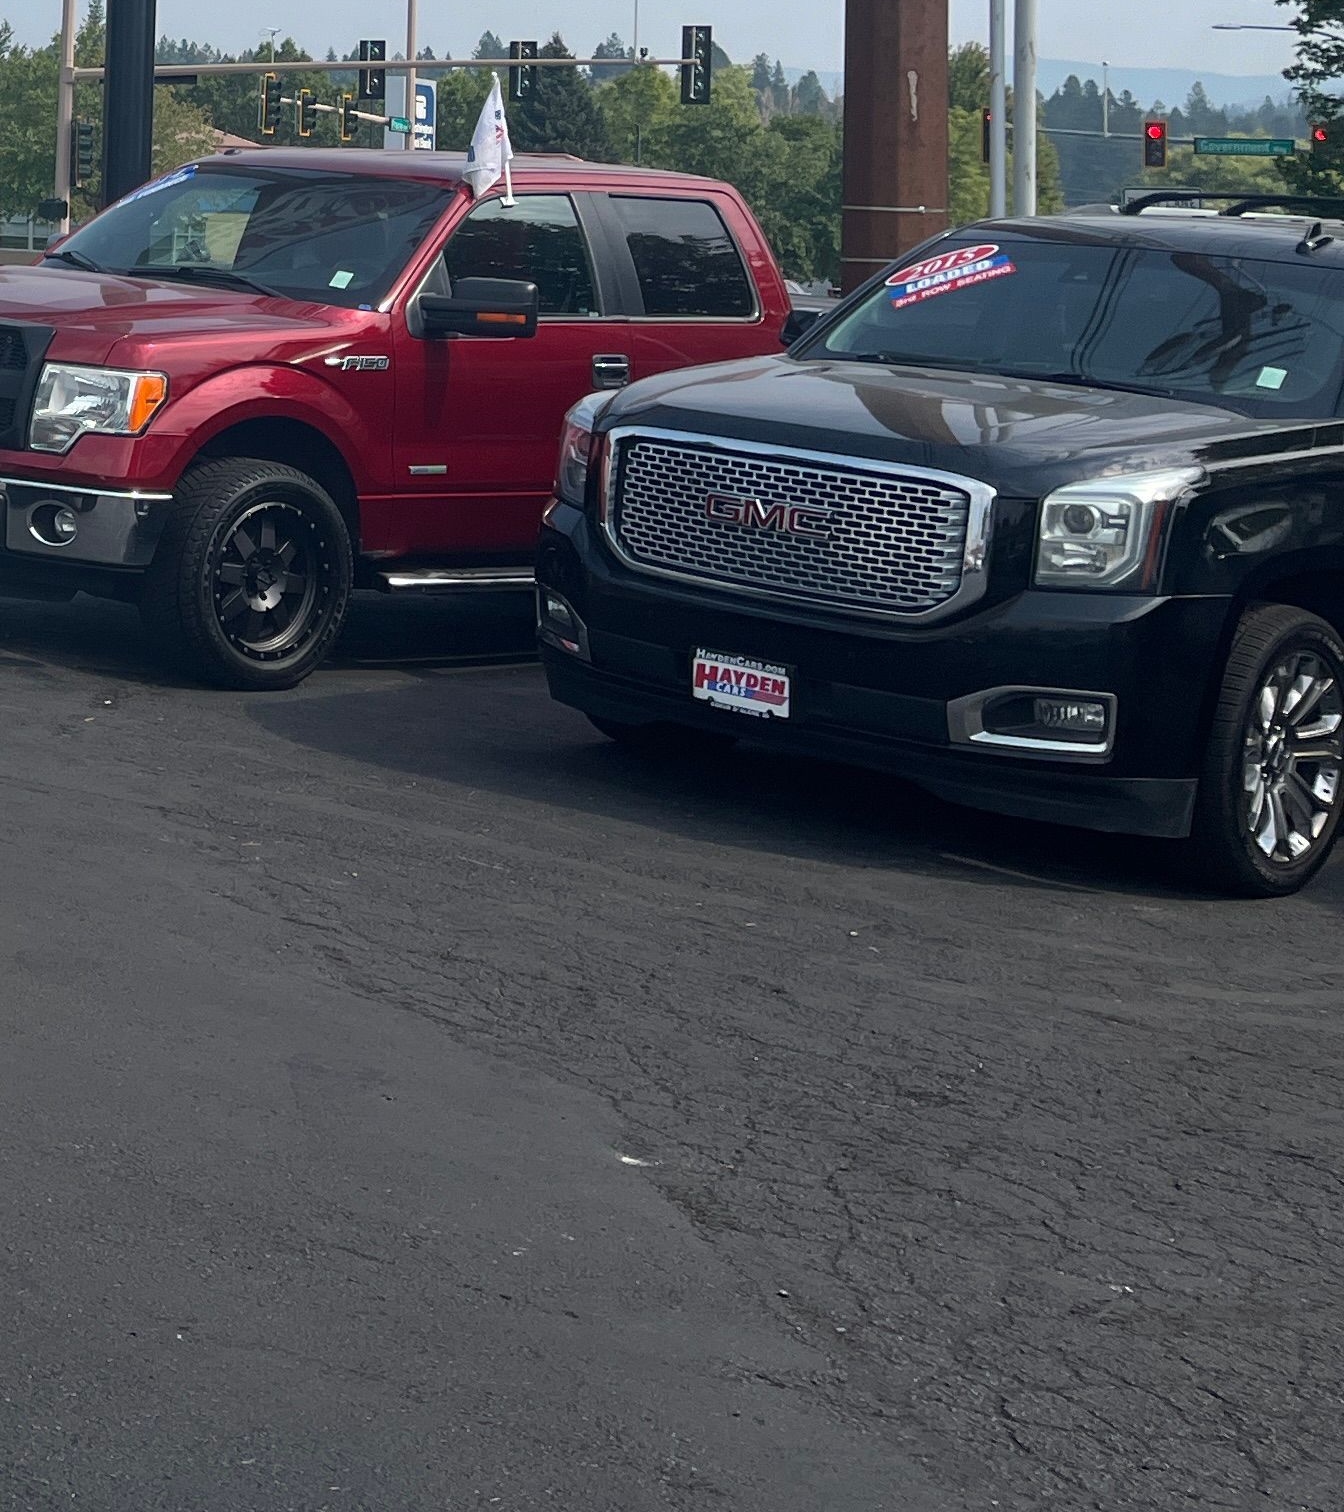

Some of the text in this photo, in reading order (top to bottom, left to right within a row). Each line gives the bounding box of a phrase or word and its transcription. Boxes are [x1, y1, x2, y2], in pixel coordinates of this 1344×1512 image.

[905, 248, 977, 280] 2015
[905, 259, 994, 294] LOADED
[921, 283, 953, 298] ROW
[956, 265, 1012, 287] SEATING
[705, 492, 833, 540] GMC
[694, 663, 786, 695] HAYDEN
[715, 682, 747, 697] CARS
